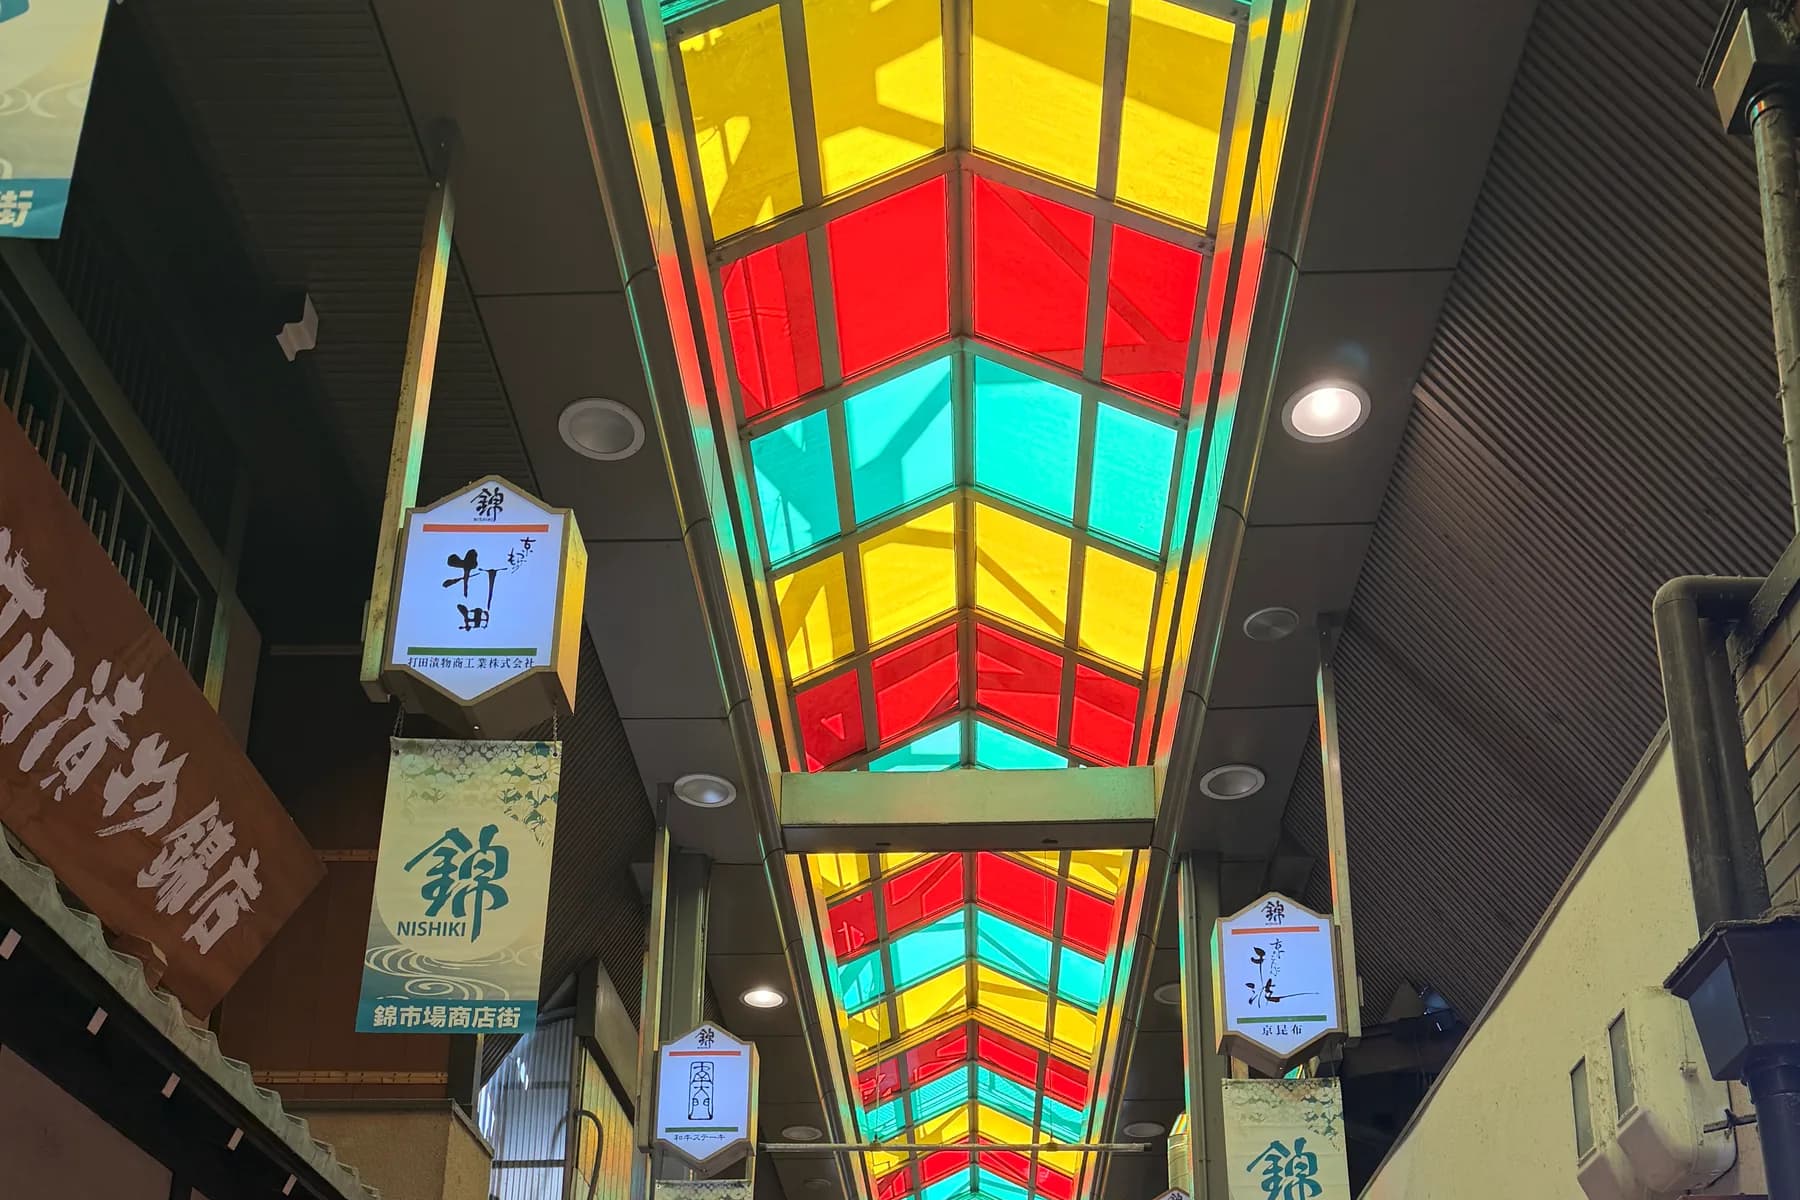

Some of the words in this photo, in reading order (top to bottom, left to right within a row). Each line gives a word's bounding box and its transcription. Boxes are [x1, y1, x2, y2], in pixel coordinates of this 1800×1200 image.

[470, 487, 504, 522] 錦
[442, 549, 508, 632] 打田
[407, 656, 535, 669] 打田漬物商工業株式会社
[403, 824, 509, 943] 錦
[1261, 900, 1285, 926] 錦
[397, 920, 466, 938] NISHIKI
[373, 1004, 520, 1029] 錦市場商店街
[694, 1028, 715, 1049] 錦
[1262, 1024, 1303, 1037] 京昆布
[673, 1133, 726, 1142] 和牛ステーキ
